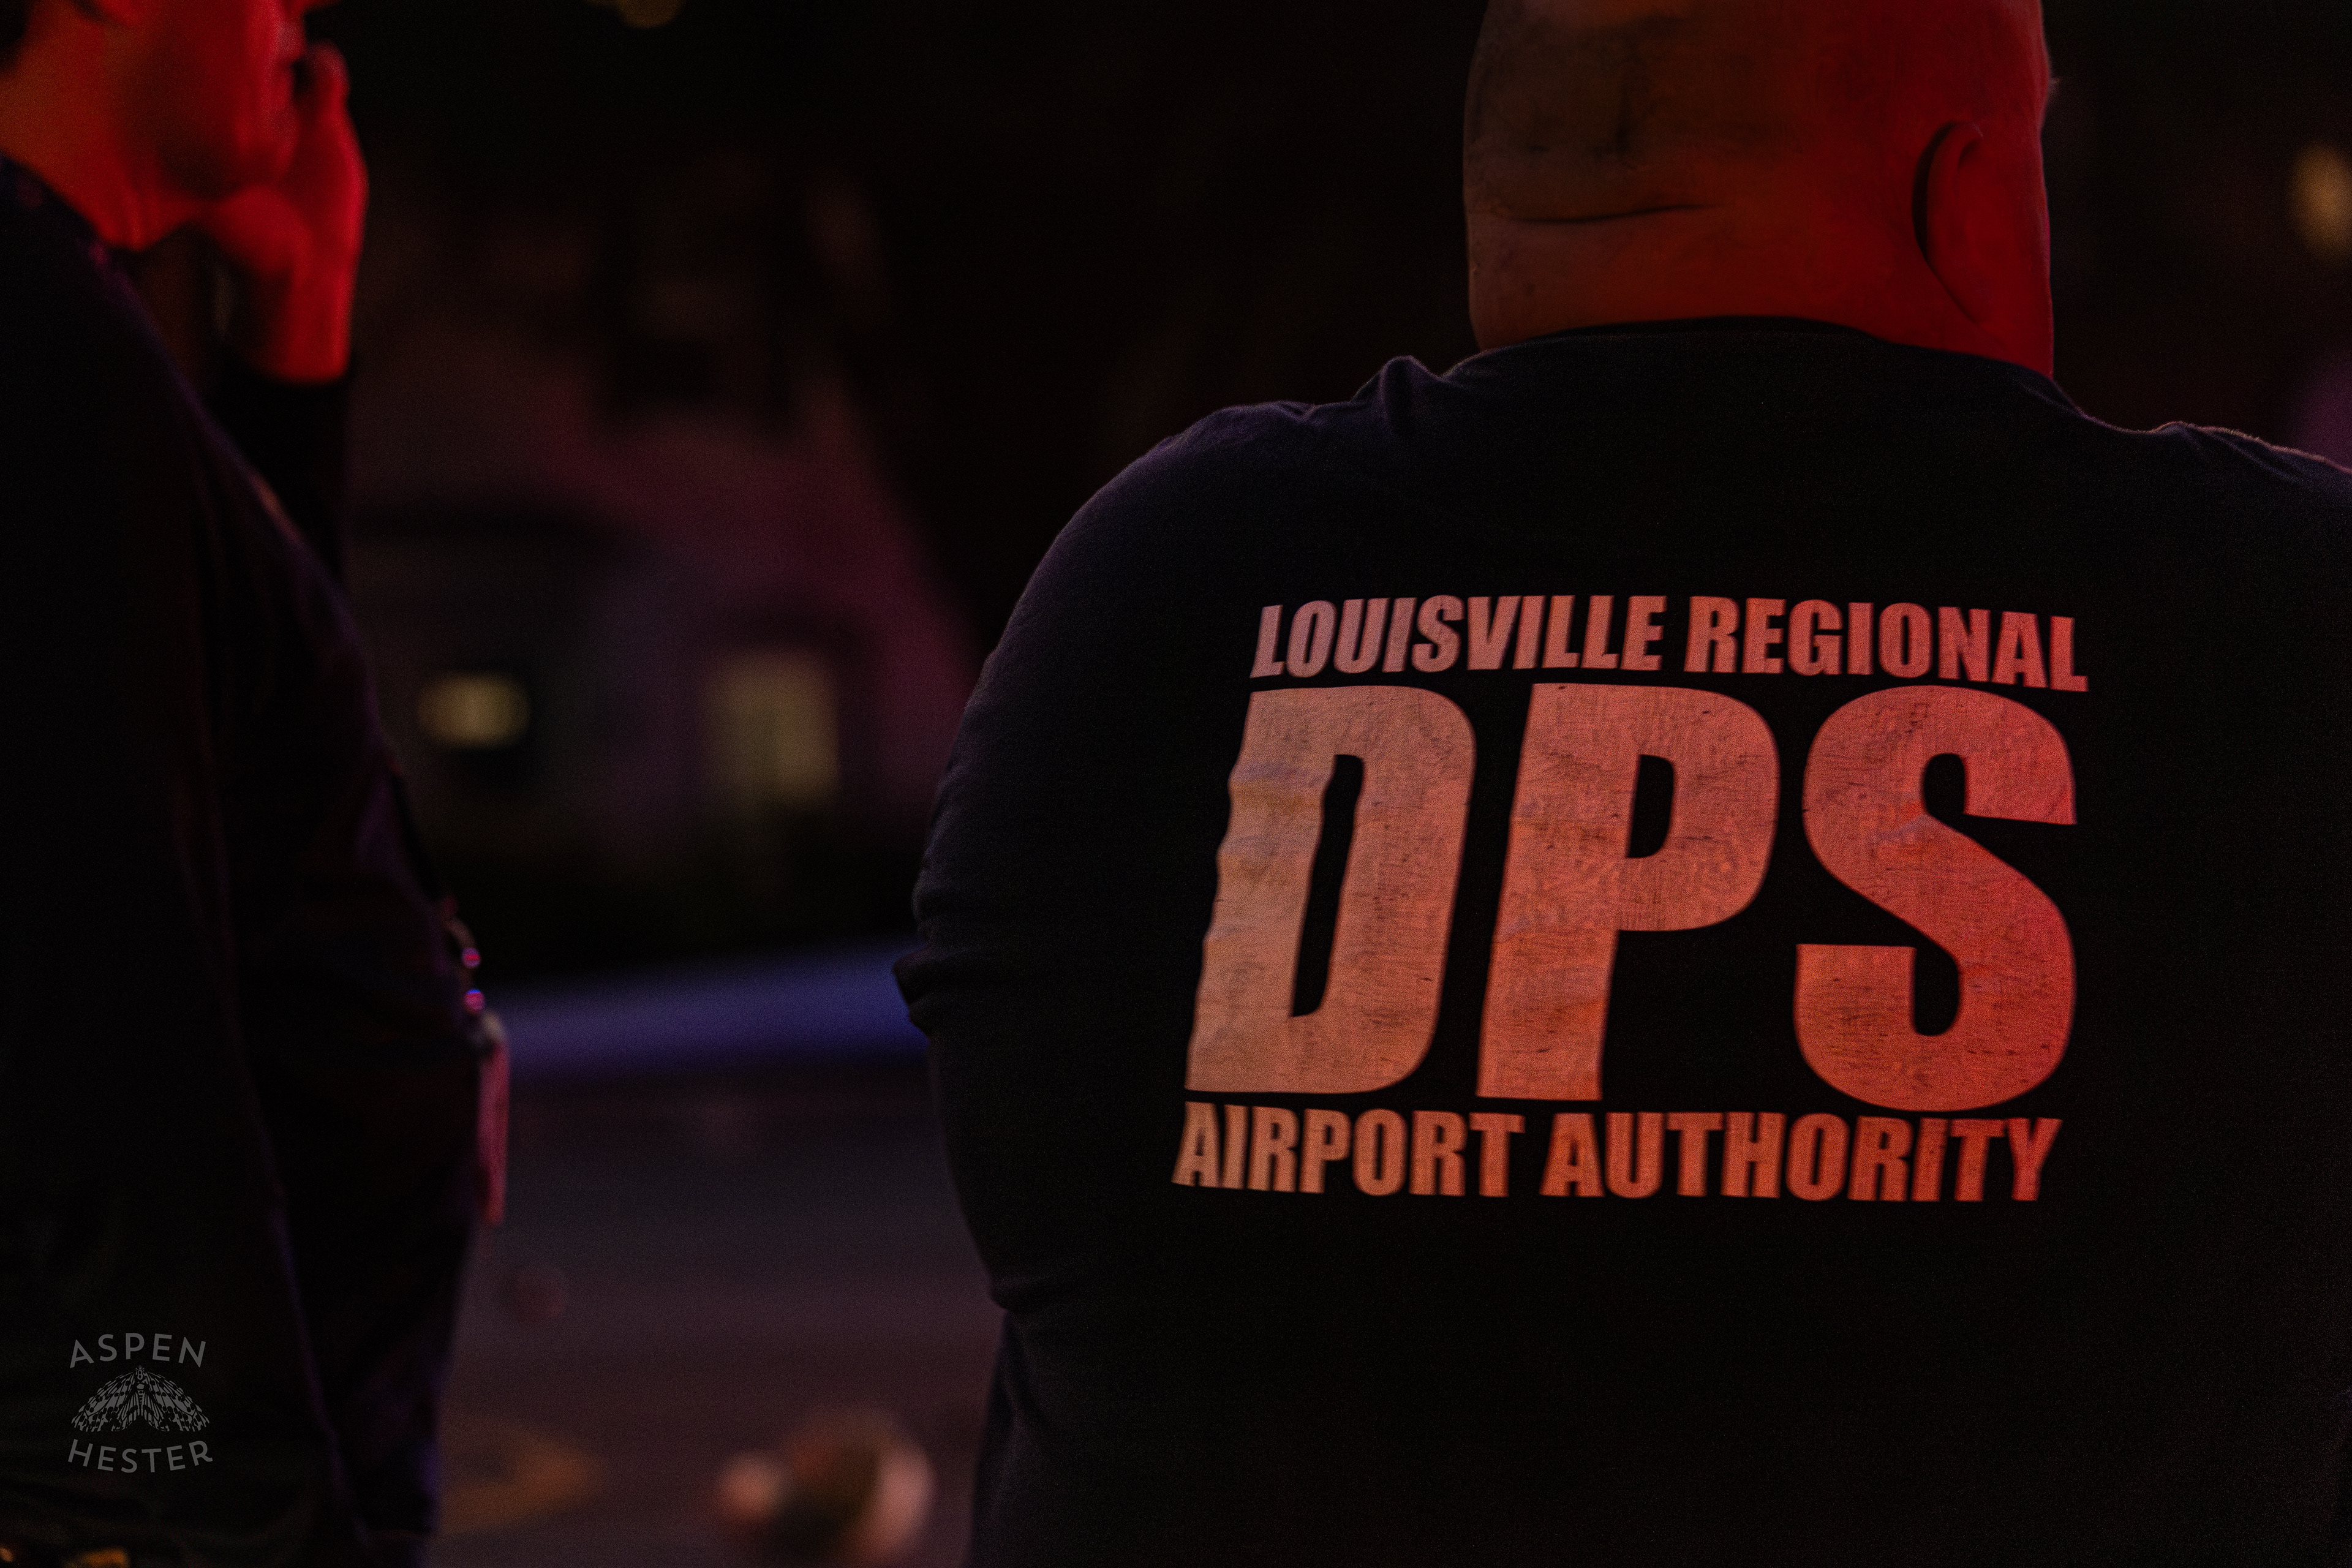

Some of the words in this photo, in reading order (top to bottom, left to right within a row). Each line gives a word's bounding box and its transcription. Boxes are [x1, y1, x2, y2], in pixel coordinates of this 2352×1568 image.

[1250, 595, 1667, 678] LOUISVILLE
[1684, 595, 2088, 693] REGIONAL
[1185, 682, 2077, 1112] DPS
[1172, 1101, 1525, 1197] AIRPORT
[1540, 1112, 2062, 1202] AUTHORITY
